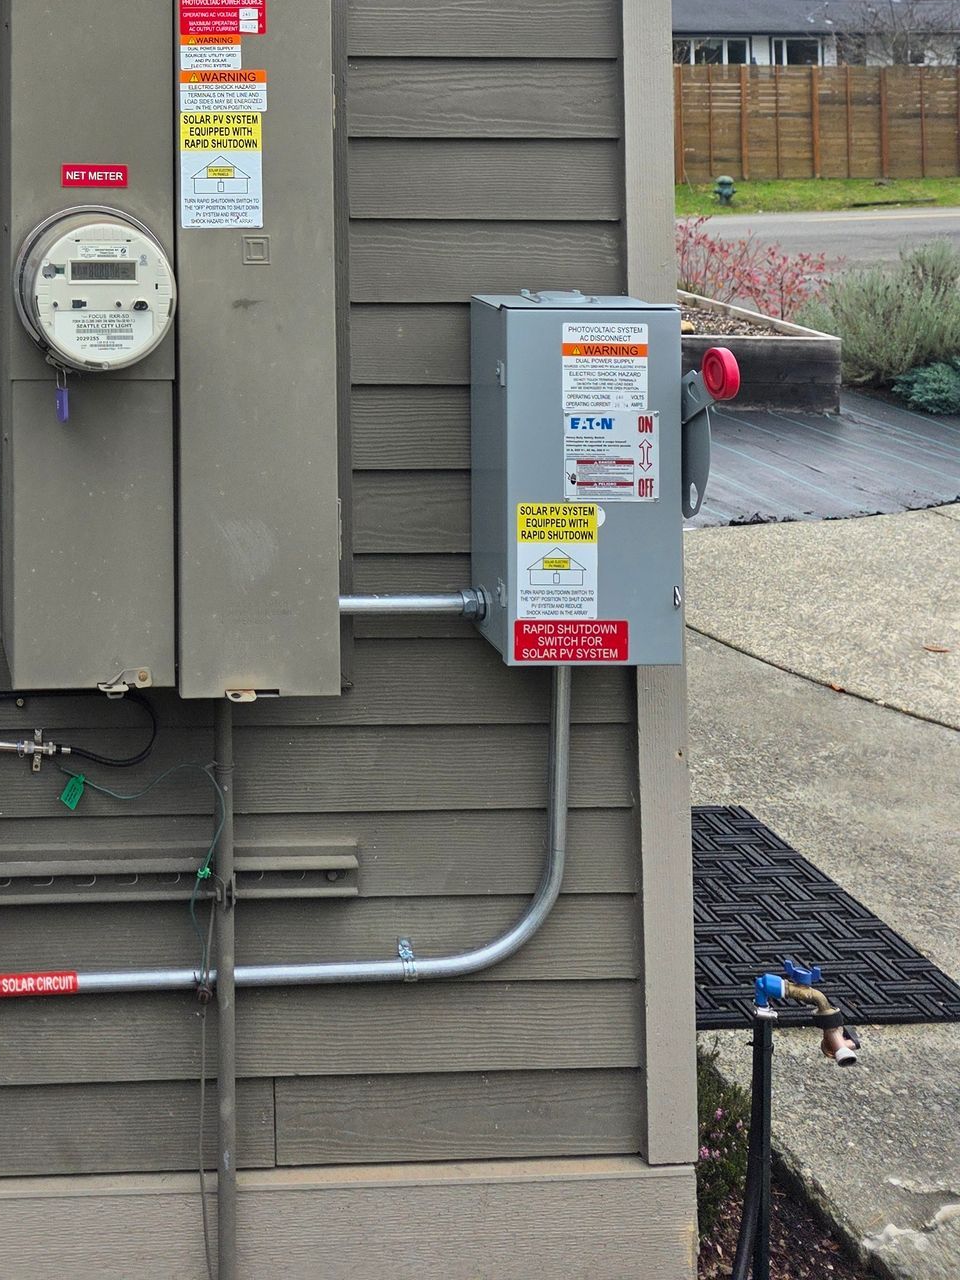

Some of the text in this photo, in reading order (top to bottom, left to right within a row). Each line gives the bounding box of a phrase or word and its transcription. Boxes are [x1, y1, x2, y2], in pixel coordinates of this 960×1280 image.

[200, 73, 256, 82] WARNING
[183, 115, 258, 124] SOLAR PV SYSTEM
[189, 127, 252, 136] EQUIPPED WITH
[185, 139, 257, 148] RAPID SHUTDOWN
[66, 171, 123, 181] NET METER
[584, 346, 638, 355] WARNING
[571, 418, 613, 429] EATON
[638, 416, 653, 433] ON
[638, 479, 654, 497] OFF
[520, 506, 595, 516] SOLAR PV SYSTEM
[526, 519, 589, 528] EQUIPPED WITH
[521, 531, 594, 540] RAPID SHUTDOWN
[523, 624, 617, 634] RAPID SHUTDOWN
[538, 636, 602, 646] SWITCH FOR
[522, 648, 618, 659] SOLAR PV SYSTEM
[2, 978, 34, 992] SOLAR
[36, 975, 74, 991] CIRCUIT
